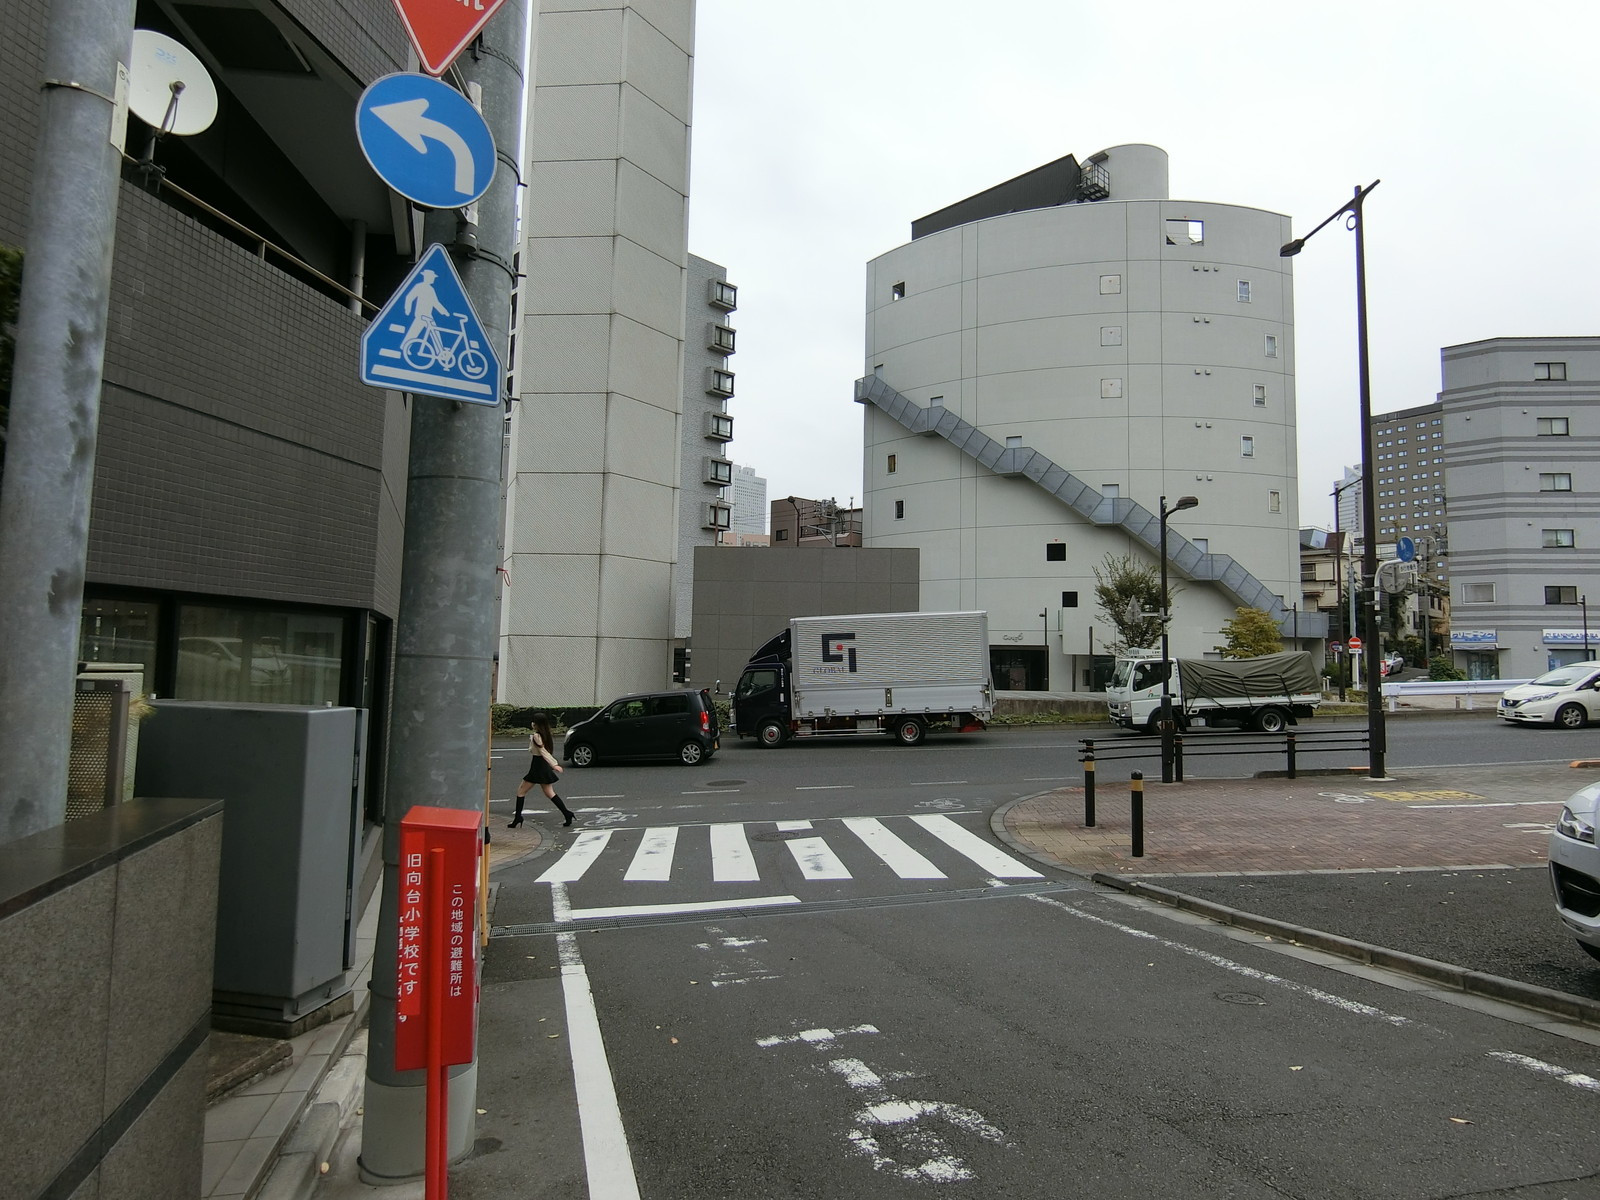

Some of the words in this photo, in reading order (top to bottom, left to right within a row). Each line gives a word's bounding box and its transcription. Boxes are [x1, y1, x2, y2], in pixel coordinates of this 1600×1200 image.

[1452, 630, 1494, 639] クリーニング
[812, 666, 847, 674] GLOBAL
[404, 852, 422, 996] 旧向台小学校です
[449, 884, 464, 997] この地域の避難所は
